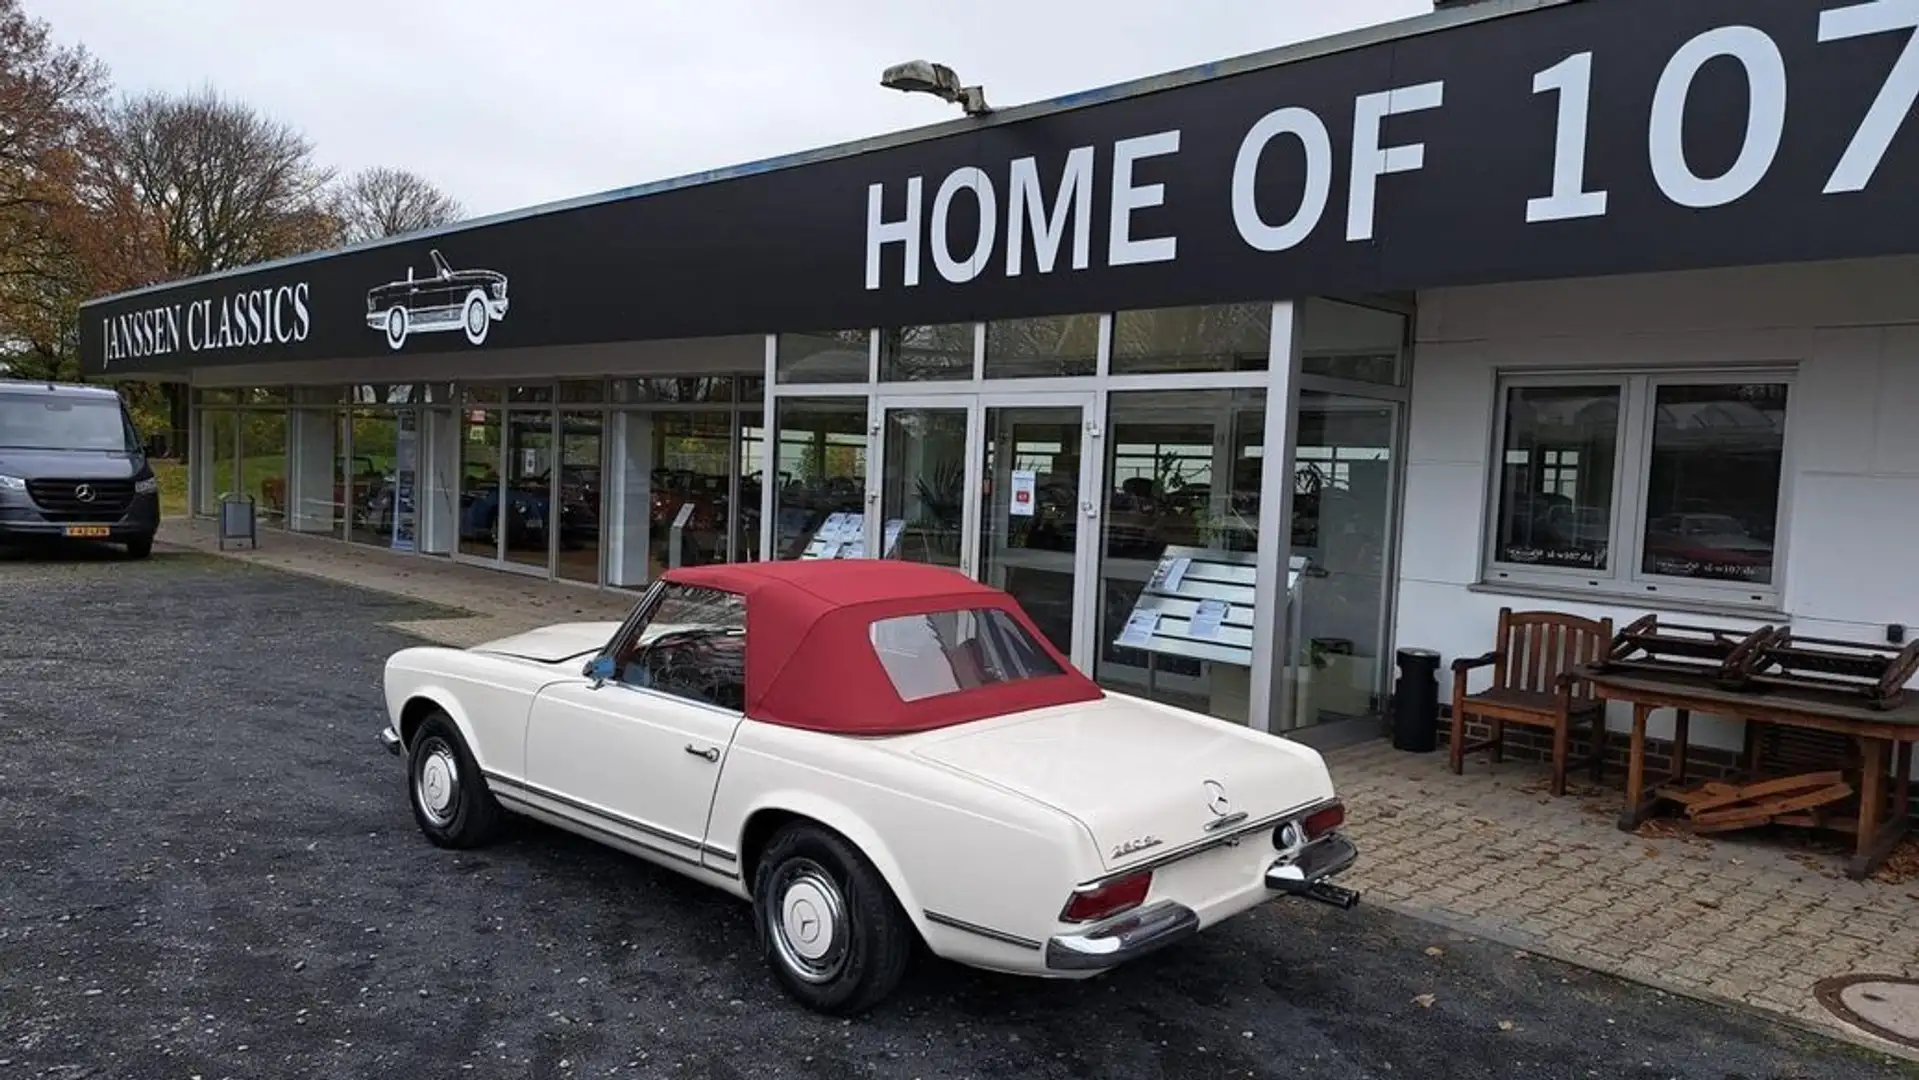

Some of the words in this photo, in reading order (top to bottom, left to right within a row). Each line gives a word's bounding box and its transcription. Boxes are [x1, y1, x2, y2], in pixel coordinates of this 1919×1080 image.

[866, 130, 1180, 289] HOME
[1232, 81, 1443, 251] OF
[1526, 0, 1919, 222] 107
[103, 304, 181, 369] JANSSEN
[187, 282, 310, 351] CLASSICS
